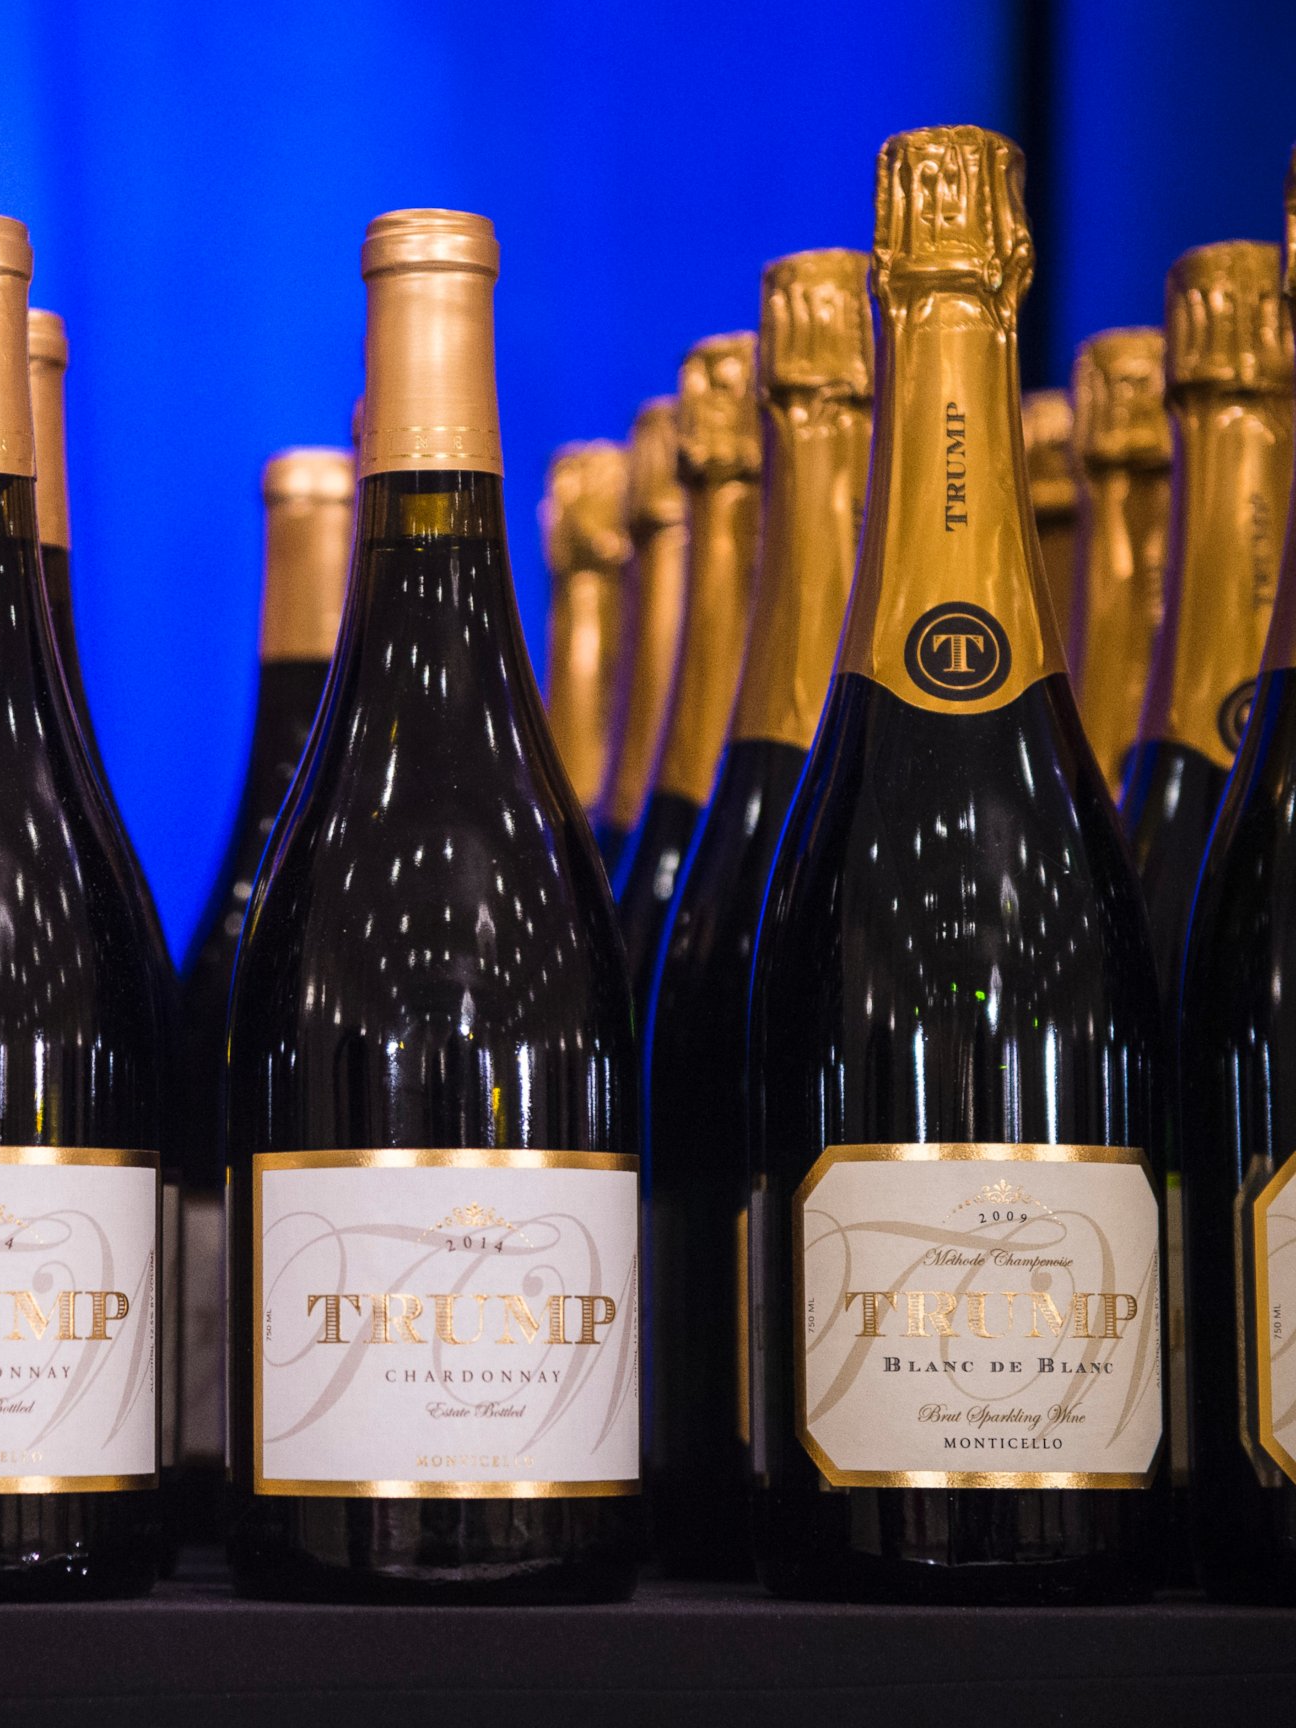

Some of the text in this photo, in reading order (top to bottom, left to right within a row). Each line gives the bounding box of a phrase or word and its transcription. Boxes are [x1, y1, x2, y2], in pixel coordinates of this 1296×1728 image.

[945, 402, 969, 532] TRUMP
[977, 1210, 1029, 1225] 2009
[445, 1235, 504, 1253] 2014
[988, 1247, 1074, 1271] Champenoise
[307, 1293, 617, 1345] TRUMP
[807, 1297, 815, 1334] 750 ML
[844, 1290, 1138, 1340] TRUMP
[1273, 1303, 1282, 1340] 750 ML
[385, 1369, 562, 1384] CHARDONNAY
[424, 1401, 527, 1419] Estate Bottled
[917, 1403, 1086, 1427] Brut Sparkling Wine
[943, 1436, 1064, 1451] MONTICELLO
